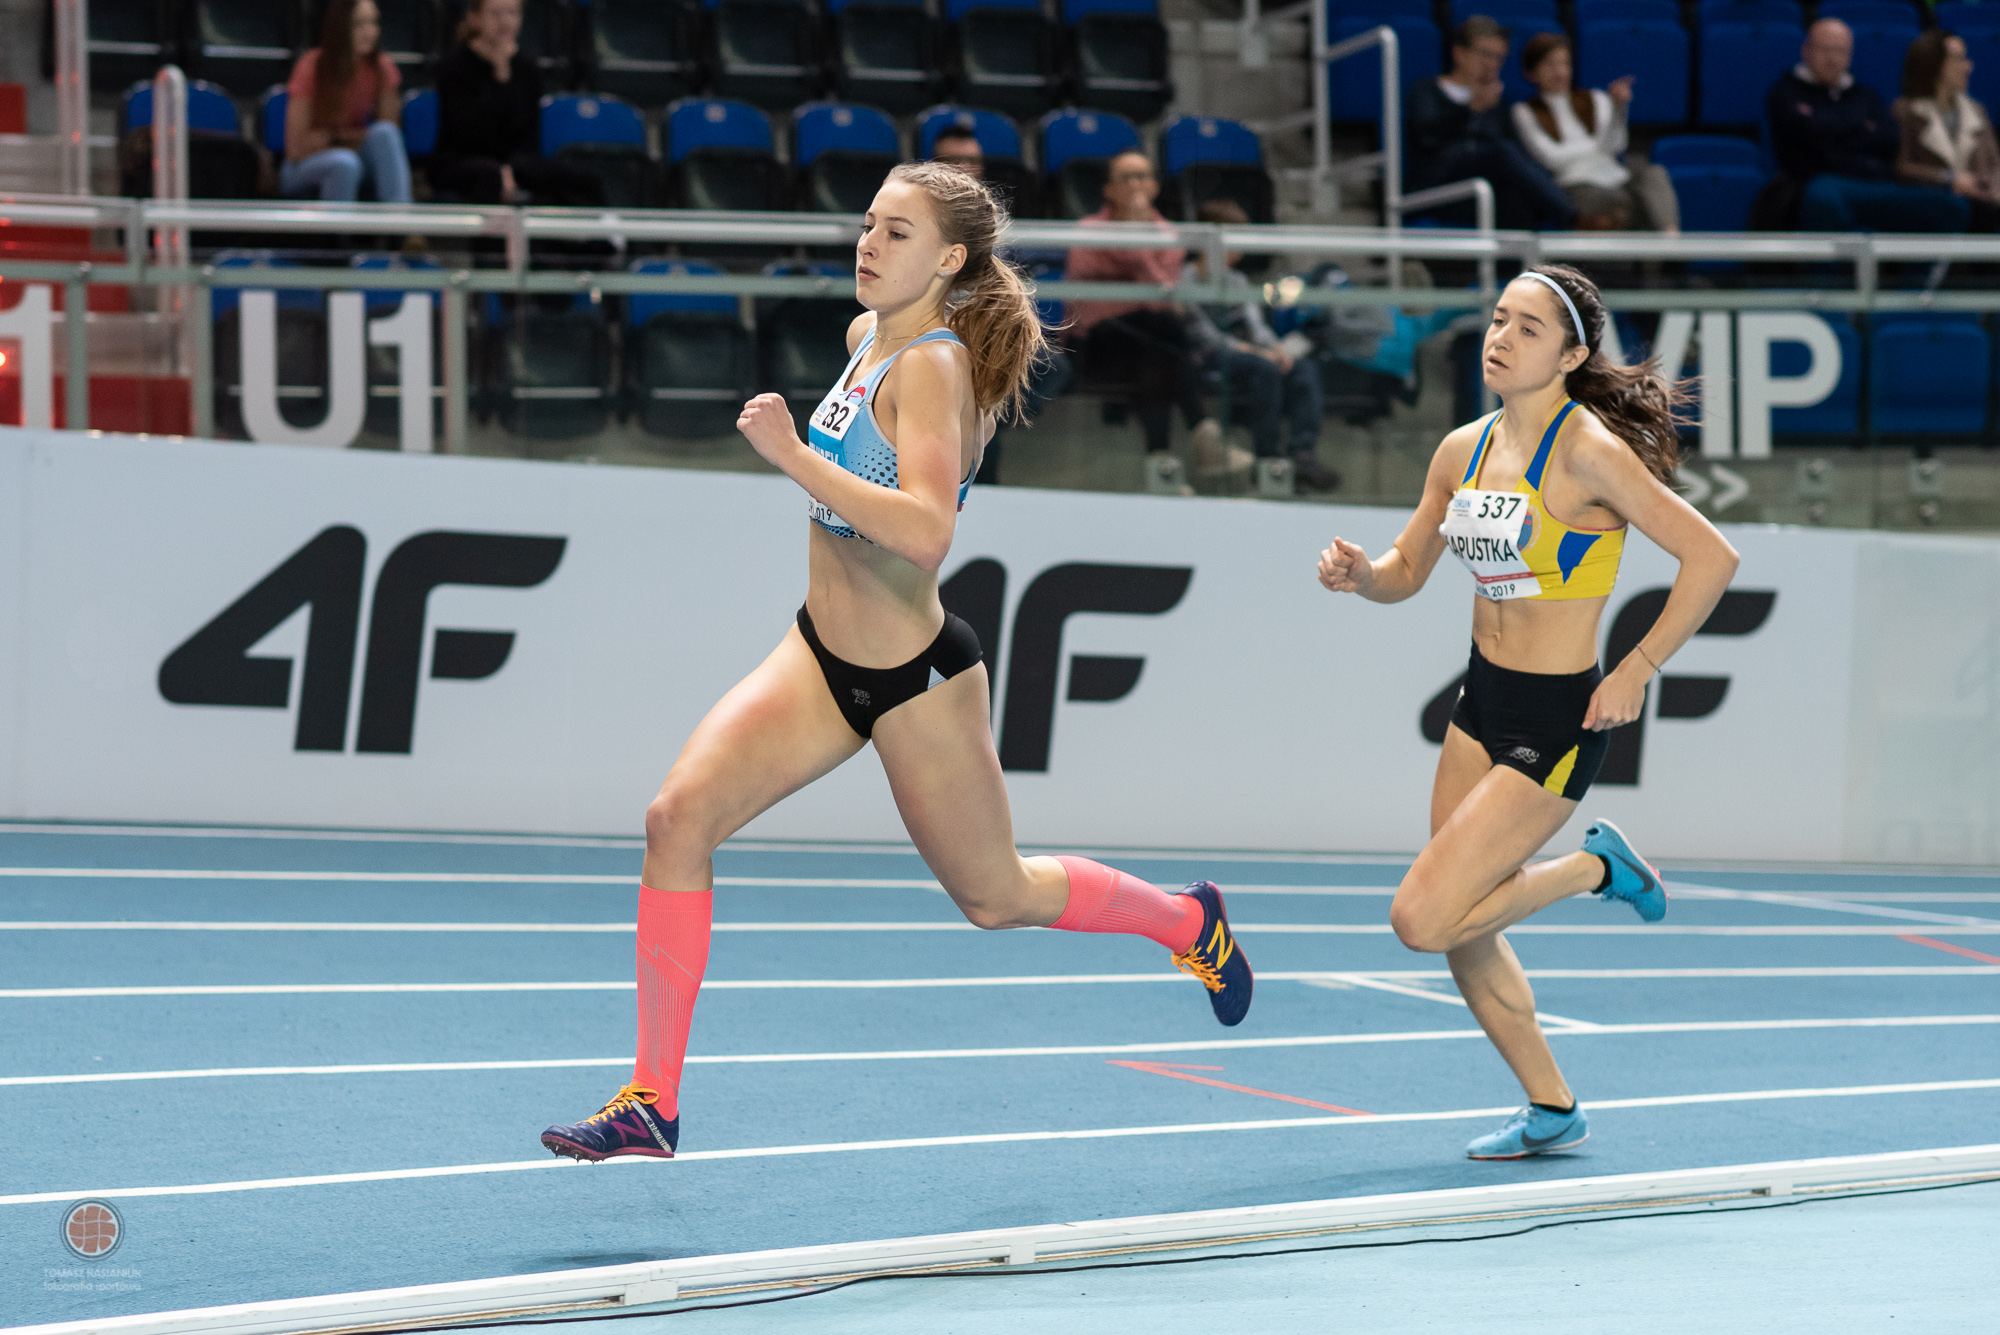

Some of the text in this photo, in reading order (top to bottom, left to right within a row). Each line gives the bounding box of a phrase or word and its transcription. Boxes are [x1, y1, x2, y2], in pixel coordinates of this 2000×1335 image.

[239, 291, 433, 453] U1
[815, 507, 832, 521] 019
[1477, 495, 1521, 519] 537
[1491, 583, 1516, 597] 2019
[157, 523, 569, 755] 4F
[1420, 587, 1776, 786] F
